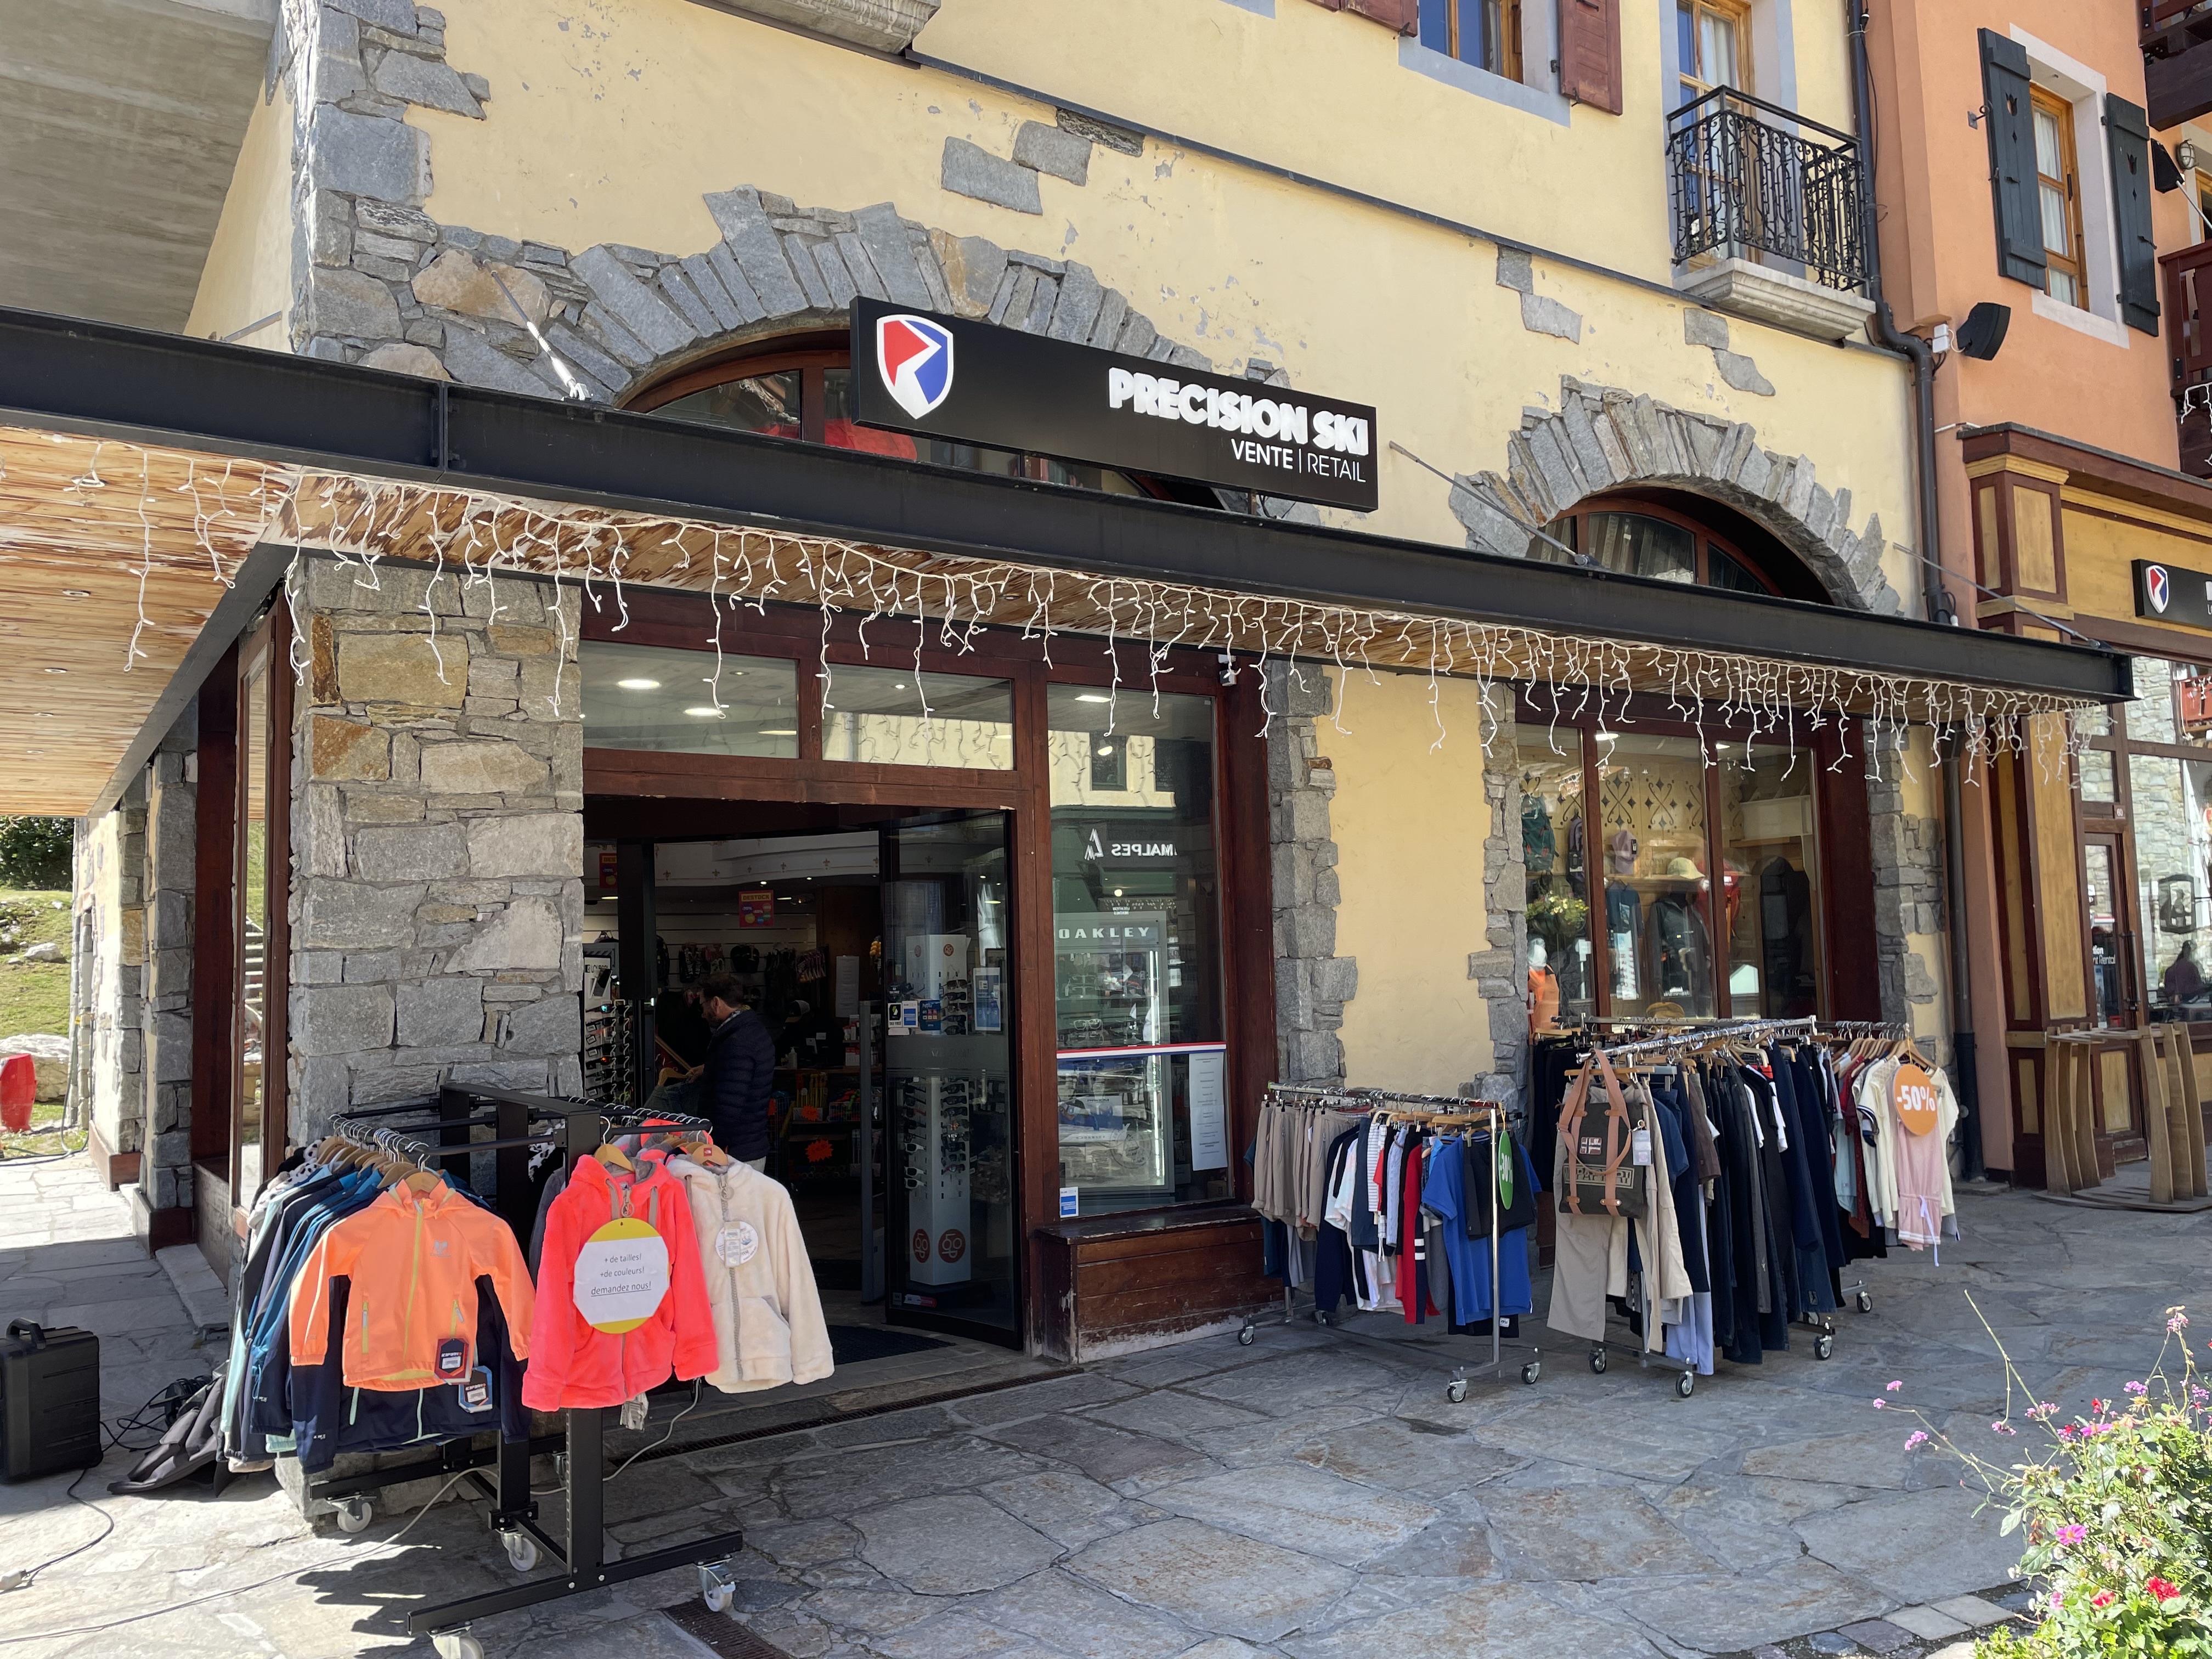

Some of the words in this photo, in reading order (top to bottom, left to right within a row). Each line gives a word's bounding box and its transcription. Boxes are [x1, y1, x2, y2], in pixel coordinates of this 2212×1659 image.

[1109, 367, 1308, 445] PRECISION
[1312, 410, 1369, 456] SKI
[1231, 438, 1293, 470] VENTE
[1307, 453, 1366, 483] RETAIL
[2117, 808, 2123, 817] 60
[1058, 927, 1149, 939] OAKLEY
[2092, 945, 2104, 955] tion
[2098, 953, 2116, 964] Rental
[1897, 1085, 1936, 1111] -50%
[1500, 1153, 1513, 1184] -30%
[620, 1253, 641, 1262] tailles!
[614, 1266, 645, 1276] couleurs!
[591, 1284, 629, 1295] demandez
[631, 1281, 651, 1290] nous!
